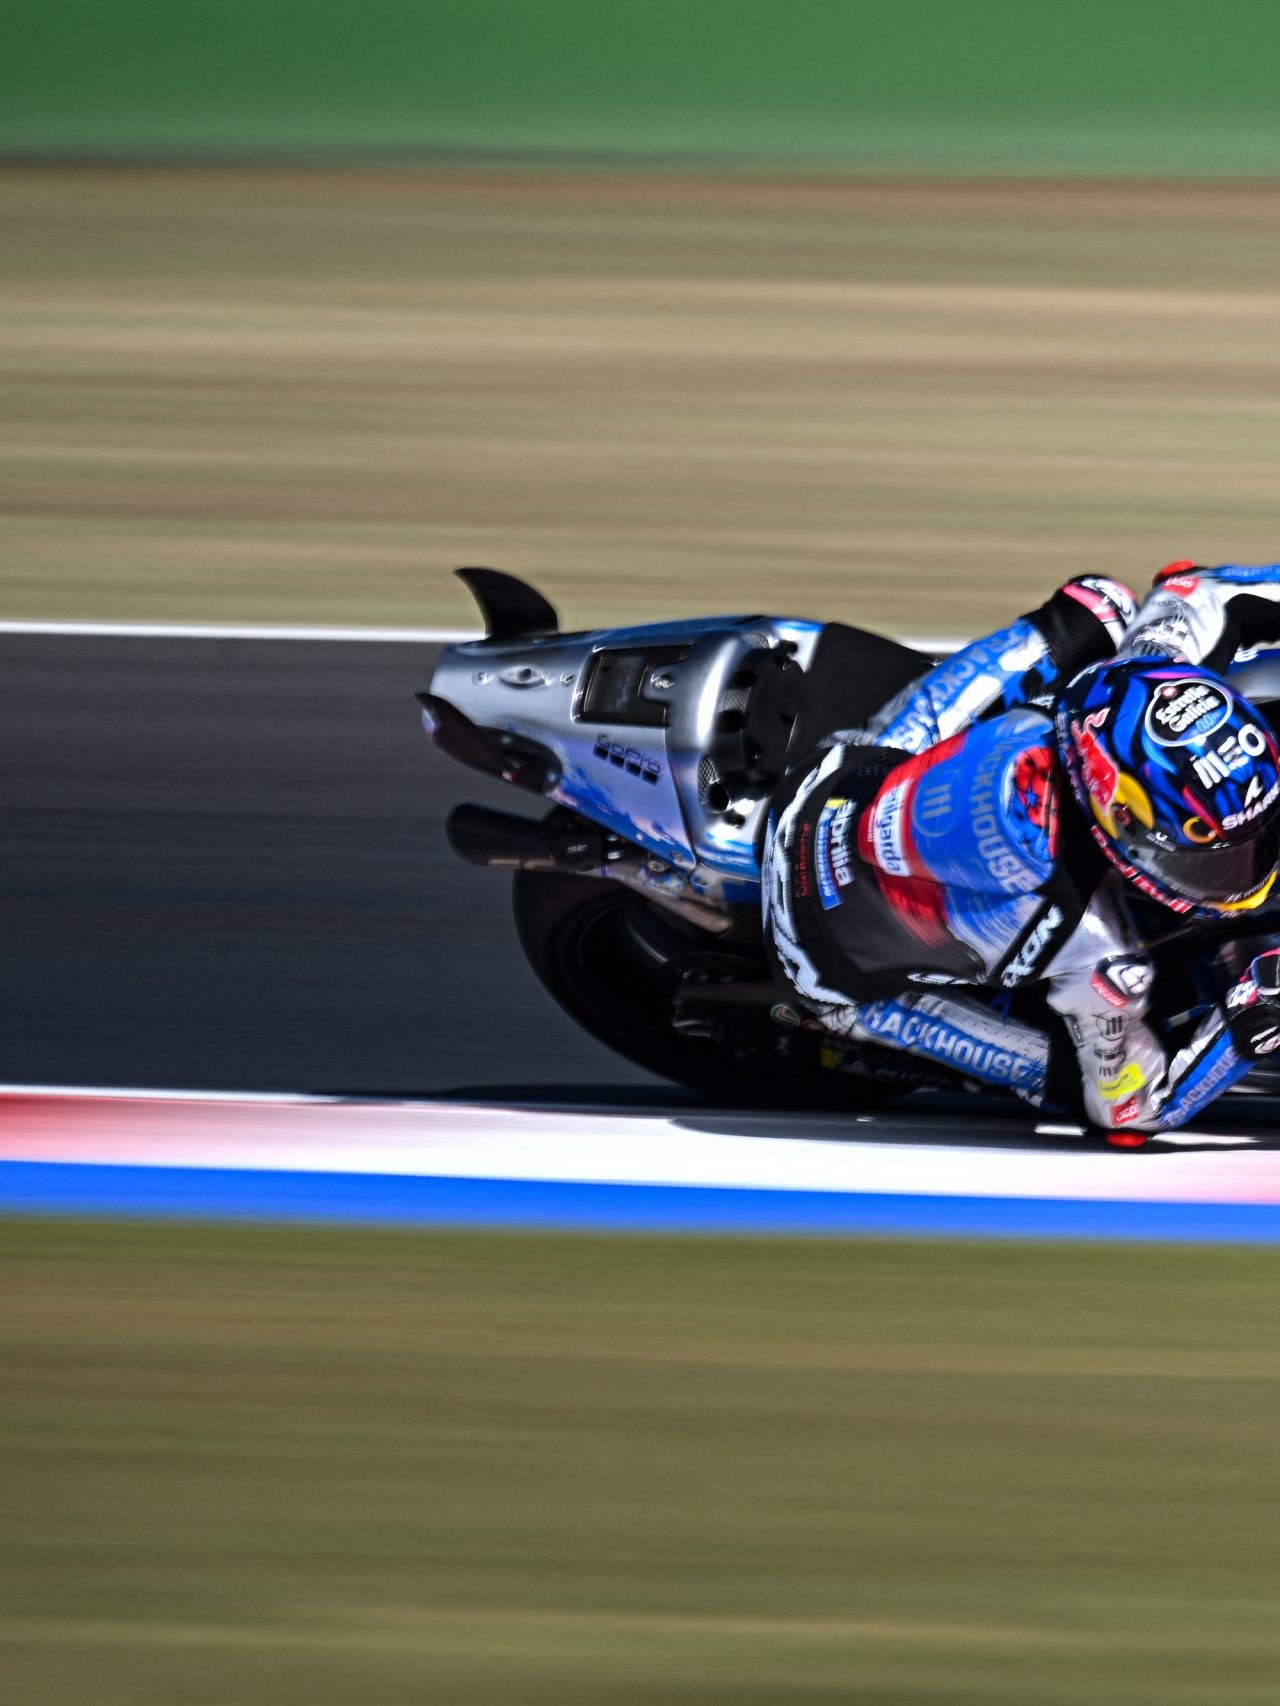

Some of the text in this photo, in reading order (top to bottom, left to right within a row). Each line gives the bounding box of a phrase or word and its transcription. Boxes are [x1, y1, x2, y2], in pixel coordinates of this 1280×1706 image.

[1156, 684, 1210, 724] Estrella
[1169, 694, 1221, 732] Galicia
[594, 733, 662, 775] GoPro
[1221, 783, 1280, 830] SHARK
[829, 800, 855, 887] aprilia
[862, 1000, 1032, 1082] RACKHOUSE
